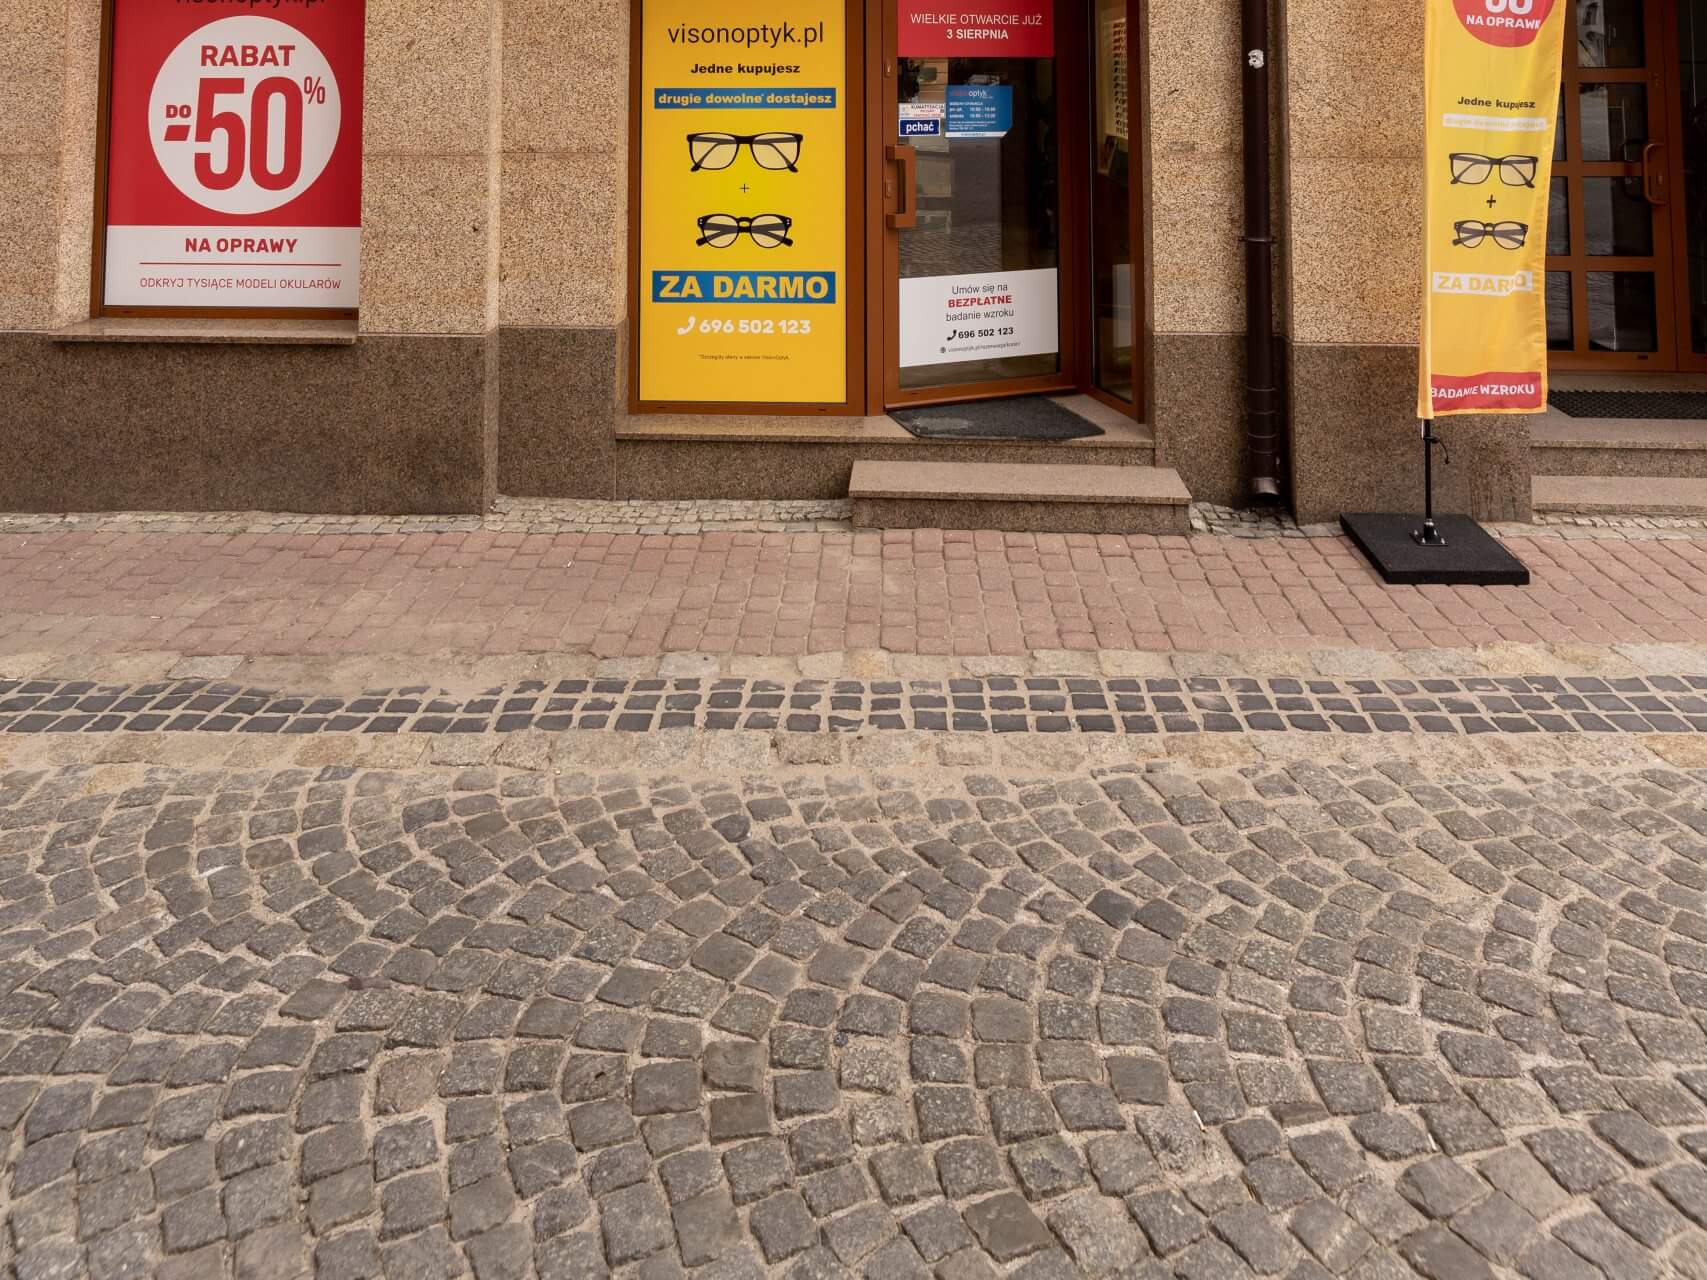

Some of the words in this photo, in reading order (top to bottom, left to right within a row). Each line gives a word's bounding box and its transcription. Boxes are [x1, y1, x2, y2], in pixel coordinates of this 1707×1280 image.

[910, 13, 956, 25] WIELKIE
[960, 14, 1019, 25] OTWARCIE
[1022, 13, 1042, 25] JUŻ
[1466, 15, 1484, 25] NA
[668, 21, 824, 48] visonoptyk.pl
[946, 29, 953, 39] 3
[956, 29, 1009, 40] SIERPNIA
[201, 45, 296, 67] RABAT
[690, 63, 733, 75] Jedne
[737, 63, 800, 77] kupujesz
[658, 93, 701, 105] drugie
[766, 93, 832, 106] dostajesz
[1458, 96, 1491, 107] Jedne
[165, 104, 192, 118] DO
[906, 121, 934, 134] pchać
[185, 238, 211, 252] NA
[216, 238, 298, 253] OPRAWY
[139, 277, 184, 288] ODKRYJ
[187, 278, 233, 290] TYSIĄCE
[236, 279, 277, 289] MODELI
[279, 277, 341, 289] OKULARÓW
[659, 275, 703, 298] ZA
[713, 276, 828, 299] DARMO
[952, 285, 979, 295] Umów
[982, 284, 994, 294] się
[997, 284, 1008, 292] na
[1438, 275, 1463, 289] ZA
[1468, 275, 1527, 291] DARO
[948, 295, 1012, 308] BEZPŁATNE
[946, 311, 981, 321] badanie
[984, 308, 1014, 318] wzroku
[699, 320, 734, 334] 696
[738, 320, 774, 334] 502
[778, 320, 811, 334] 123
[958, 330, 975, 339] 696
[978, 328, 995, 337] 502
[997, 327, 1014, 335] 123
[1480, 384, 1535, 395] WZROKU
